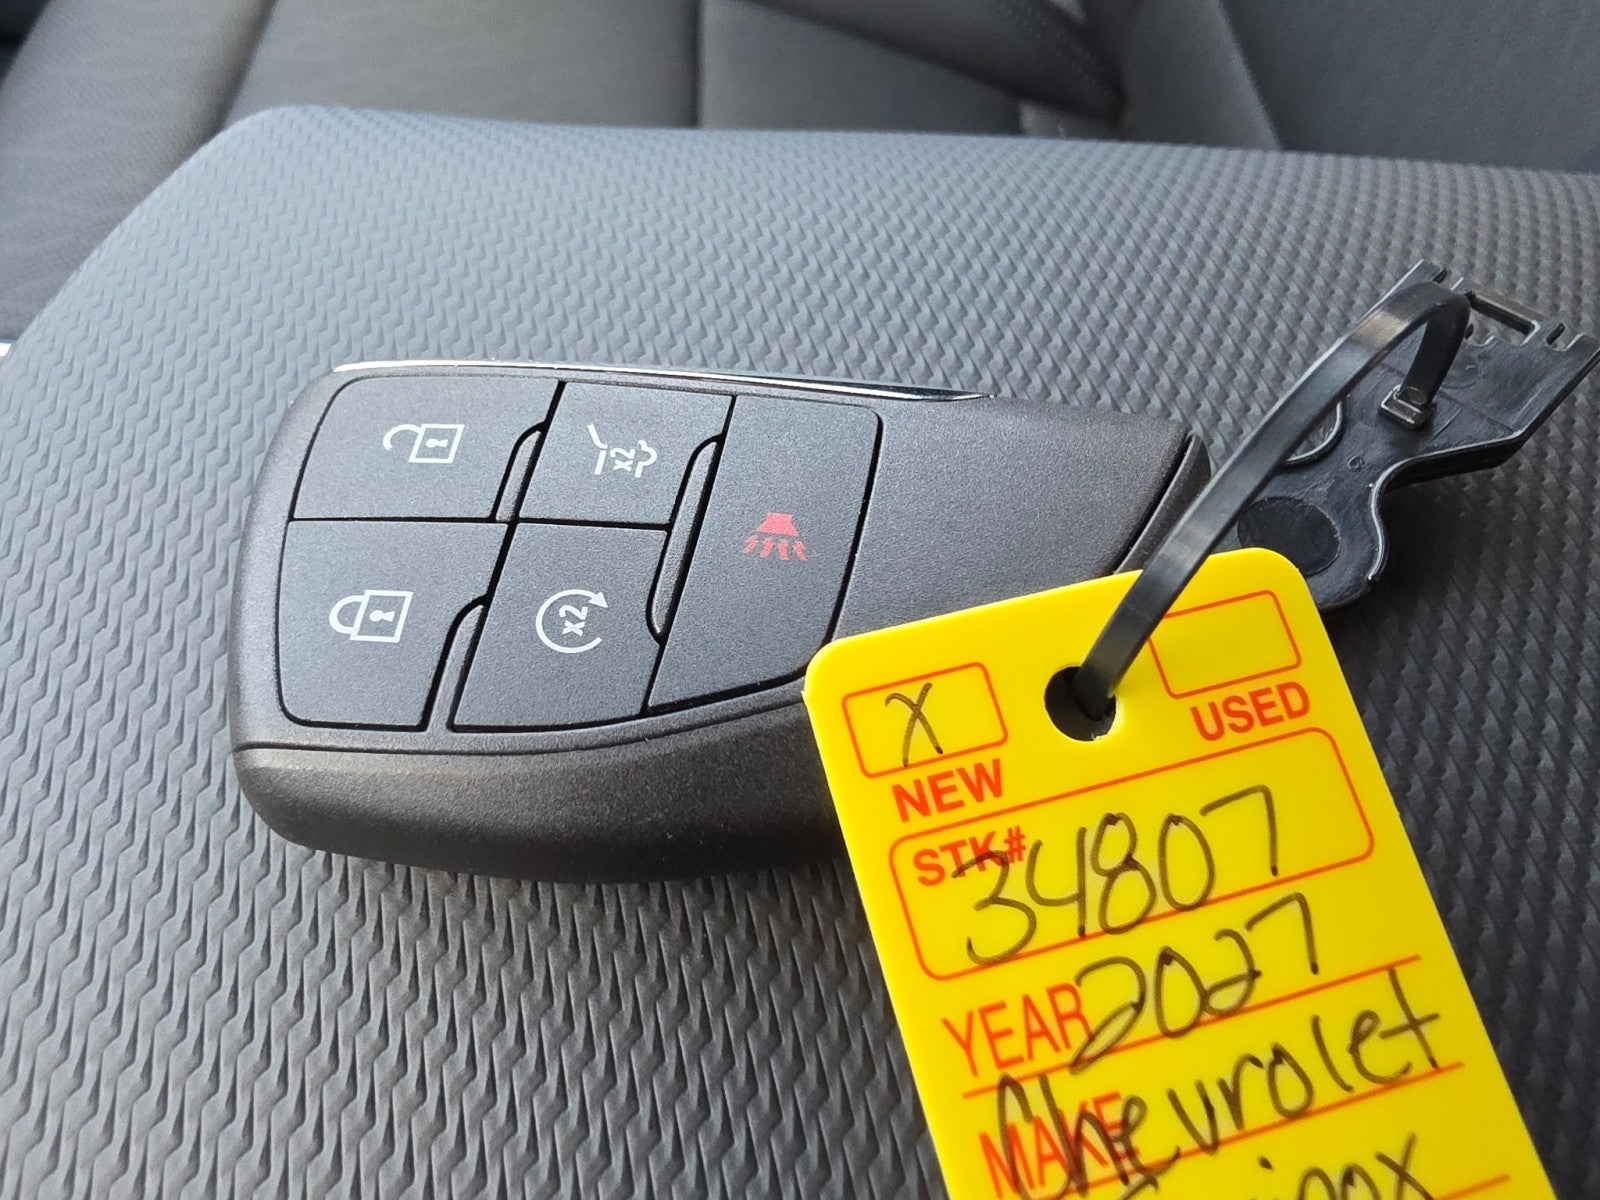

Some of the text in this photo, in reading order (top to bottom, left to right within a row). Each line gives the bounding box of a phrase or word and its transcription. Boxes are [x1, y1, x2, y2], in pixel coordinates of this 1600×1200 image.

[609, 447, 636, 472] x2
[559, 604, 588, 636] x2
[1192, 682, 1311, 741] USED
[892, 758, 1003, 822] NEW
[913, 826, 1026, 886] STK#
[952, 785, 1278, 964] 34807
[1070, 892, 1319, 1074] 2027
[942, 984, 1092, 1077] YEAR
[997, 967, 1440, 1200] Chevrolet
[979, 1092, 1139, 1198] MAKE
